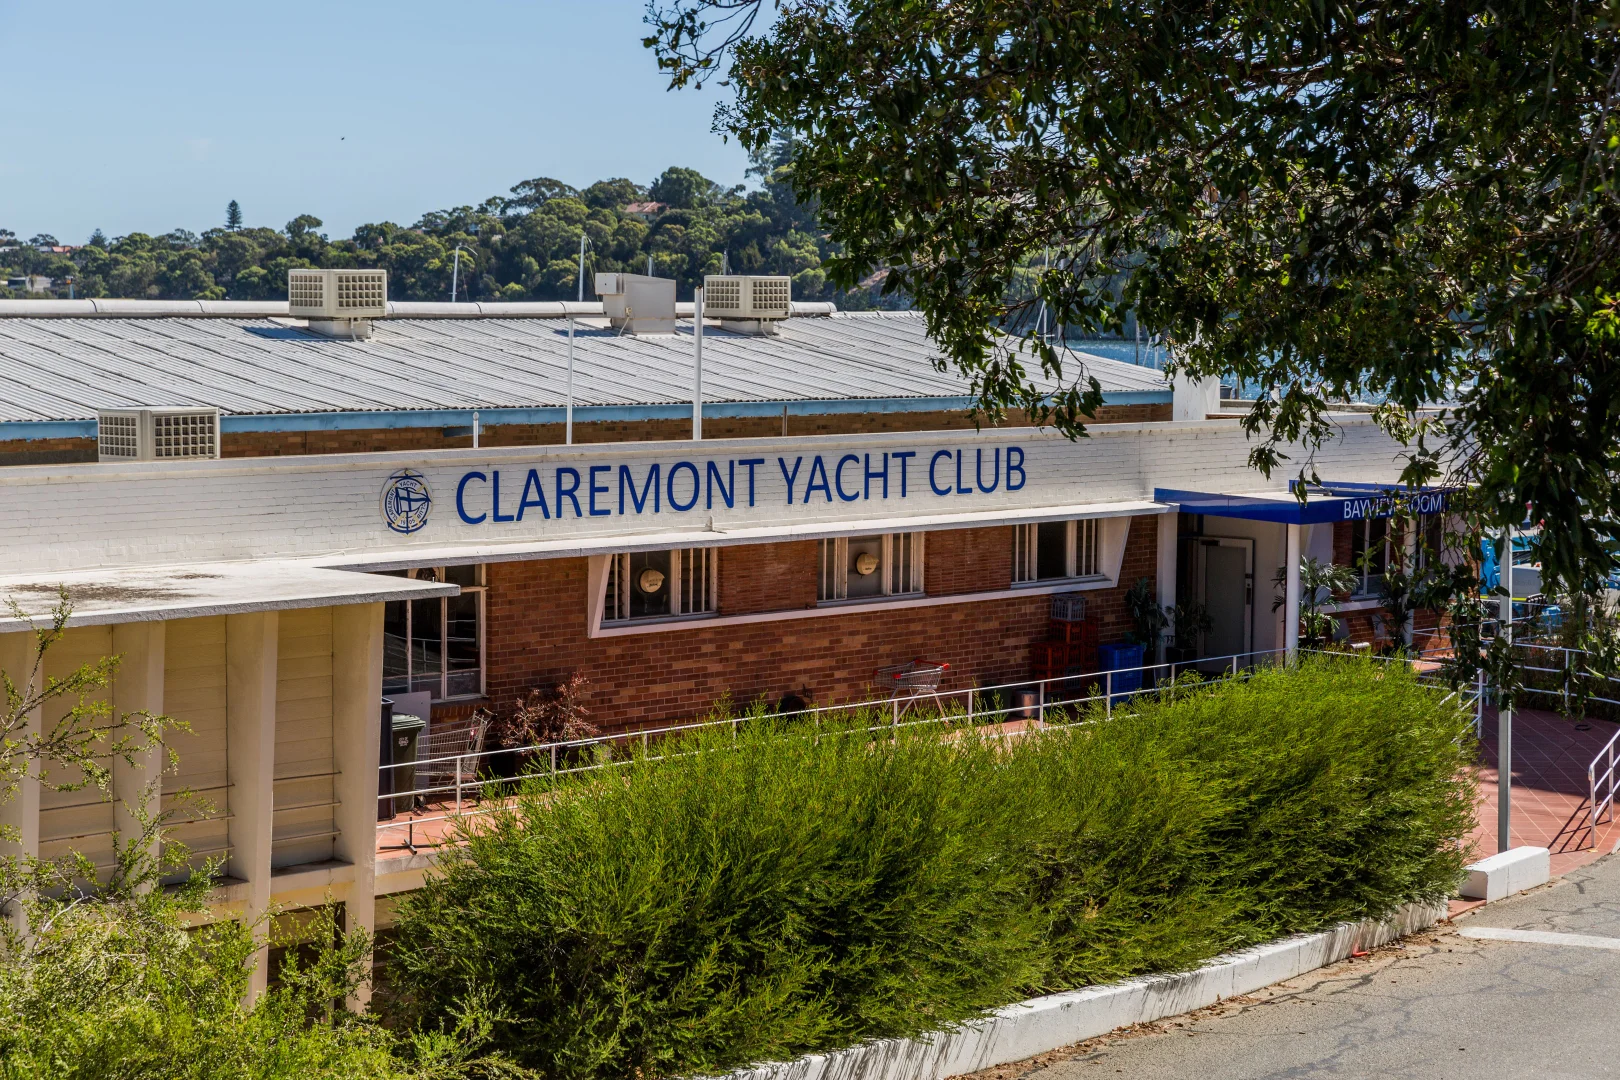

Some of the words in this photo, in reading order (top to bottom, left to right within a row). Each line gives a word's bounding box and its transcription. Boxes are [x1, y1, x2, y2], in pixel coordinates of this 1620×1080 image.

[399, 480, 418, 488] YACHT
[457, 458, 765, 525] CLAREMONT
[778, 451, 916, 504] YACHT
[929, 447, 1027, 495] CLUB
